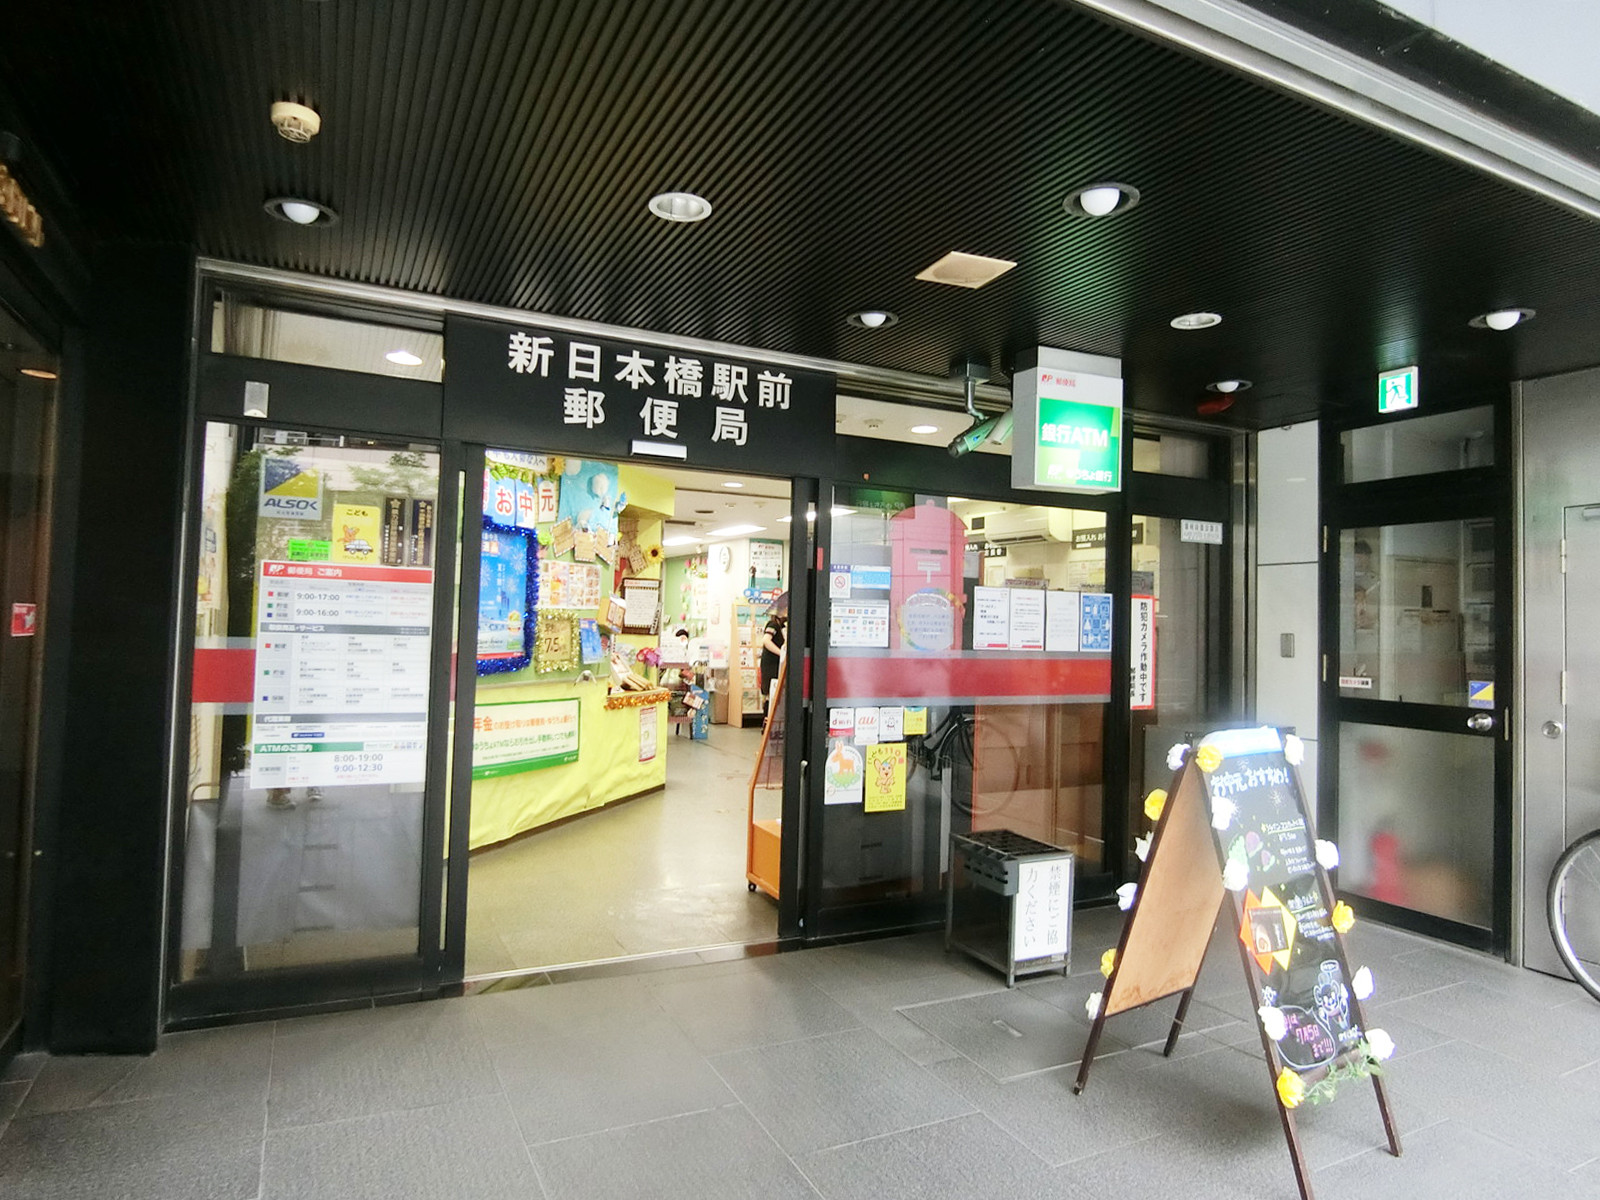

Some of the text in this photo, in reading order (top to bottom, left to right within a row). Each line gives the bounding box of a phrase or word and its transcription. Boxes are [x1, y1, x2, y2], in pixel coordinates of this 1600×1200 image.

[508, 332, 792, 411] 新日本橋駅前
[563, 387, 748, 446] 郵便局
[1041, 422, 1108, 447] 銀行ATM
[264, 498, 317, 510] ALSOK
[297, 593, 340, 601] 9:00-17:00
[296, 608, 339, 617] 9:00-16:00
[1139, 601, 1149, 703] 防犯カメラ作動中です
[334, 753, 383, 762] 8:00-19:00
[334, 763, 383, 773] 9:00-12:30
[1024, 867, 1038, 948] 力ください
[1048, 865, 1062, 946] 禁煙にご協
